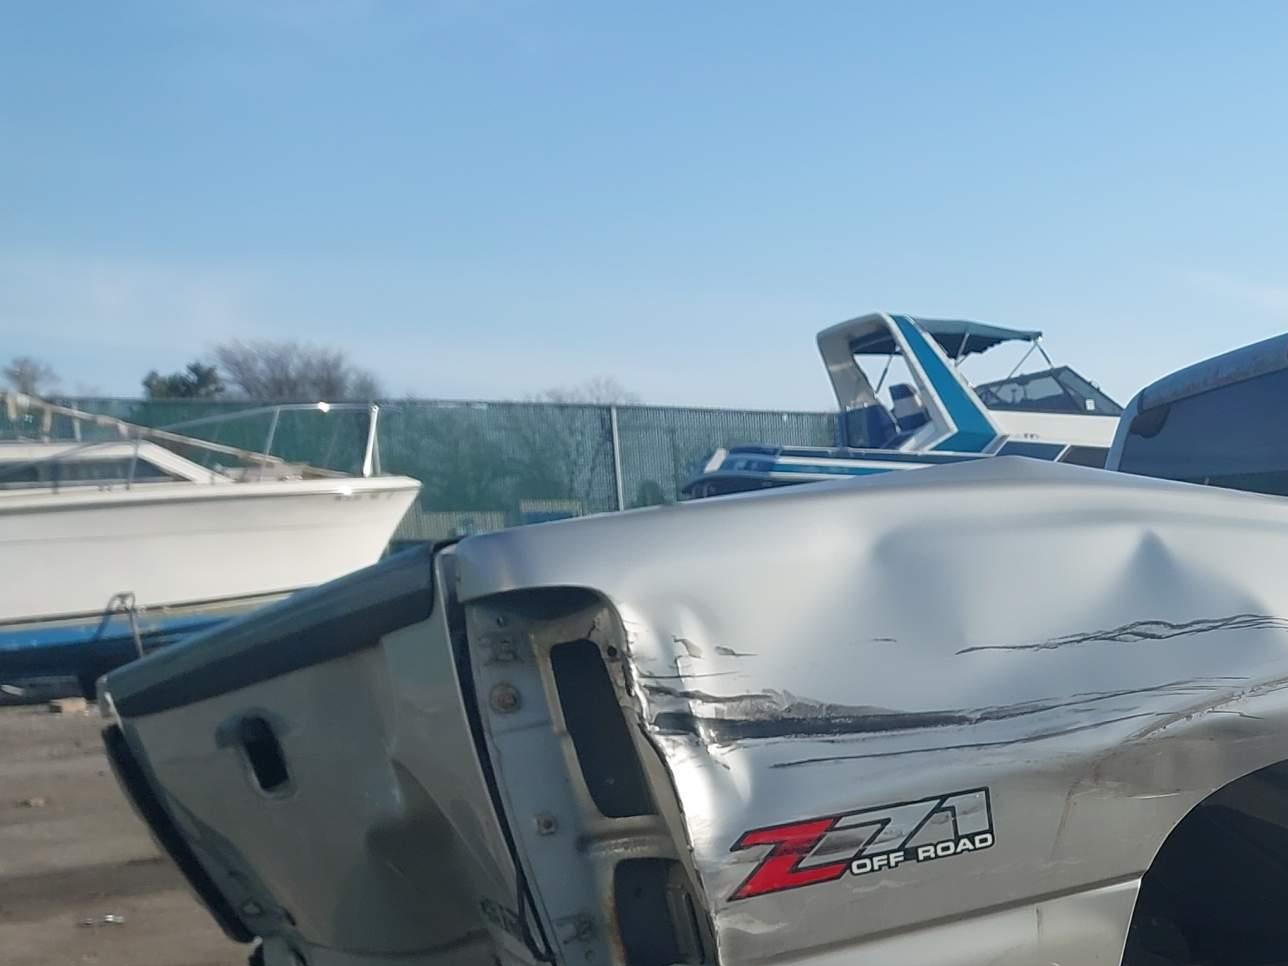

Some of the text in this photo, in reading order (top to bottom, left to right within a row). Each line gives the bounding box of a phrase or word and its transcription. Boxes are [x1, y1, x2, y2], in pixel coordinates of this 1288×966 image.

[728, 786, 993, 902] Z71
[851, 832, 994, 875] OFF ROAD
